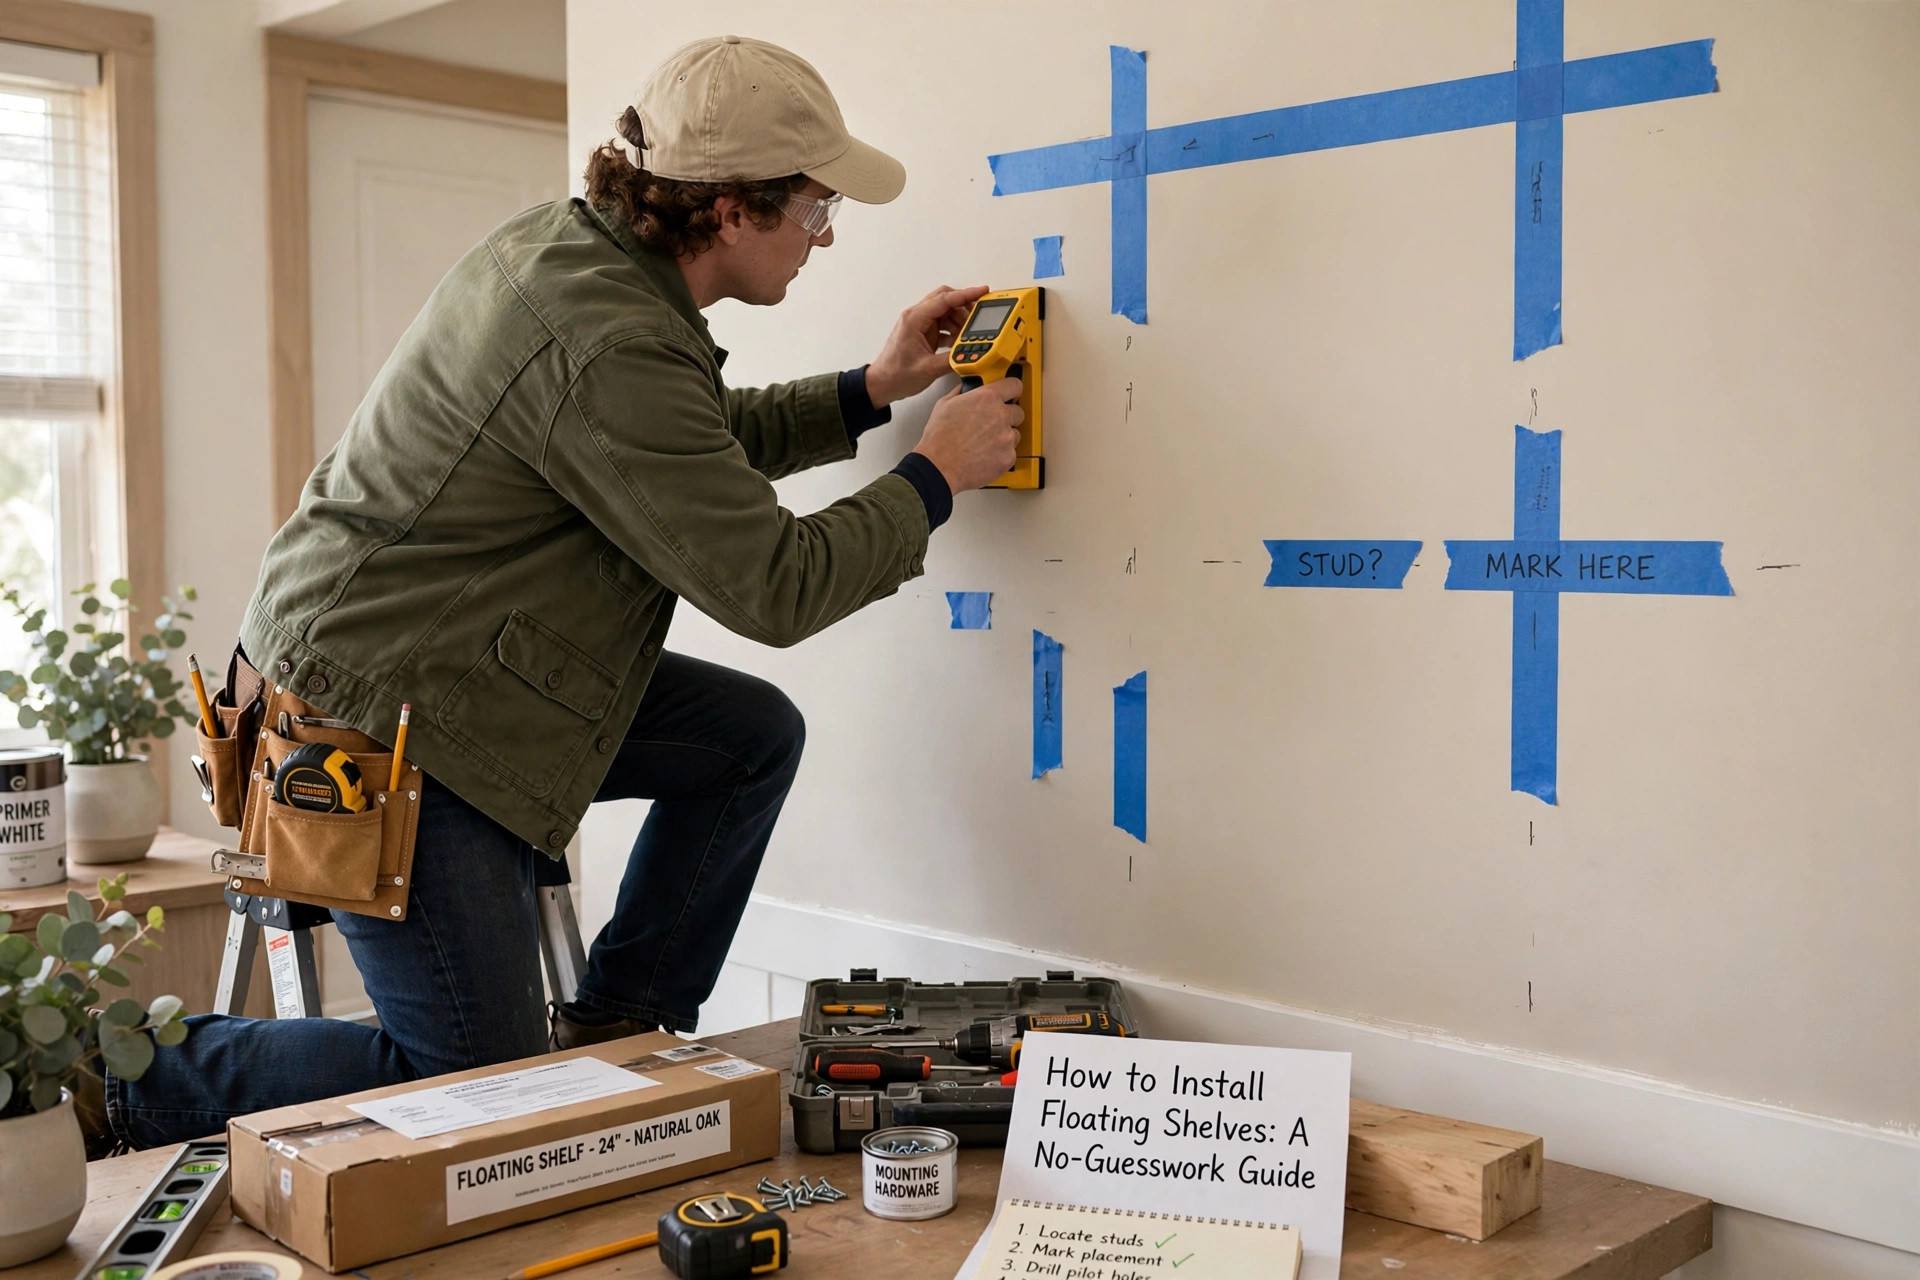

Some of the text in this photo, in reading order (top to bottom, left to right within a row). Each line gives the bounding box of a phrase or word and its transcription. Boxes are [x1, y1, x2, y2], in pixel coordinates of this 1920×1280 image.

[1297, 549, 1383, 578] STUD?
[1485, 552, 1656, 580] MARK HERE
[0, 822, 45, 843] WHITE
[1047, 1057, 1264, 1102] How to Install
[1041, 1100, 1309, 1147] Floating Shelves: A
[457, 1155, 534, 1190] FLOATING
[538, 1143, 585, 1170] SHELF
[598, 1133, 622, 1155] 24"
[634, 1116, 693, 1147] NATURAL
[695, 1109, 721, 1131] OAK
[875, 1163, 939, 1181] MOUNTING
[1034, 1141, 1316, 1189] No-Guesswork Guide
[875, 1180, 940, 1198] HARDWARE
[1018, 1223, 1144, 1247] 1. Locate studs
[1008, 1241, 1163, 1267] 2. Mark placement
[1001, 1258, 1016, 1271] 3.
[1026, 1261, 1061, 1276] Drill
[1066, 1266, 1103, 1280] pilot
